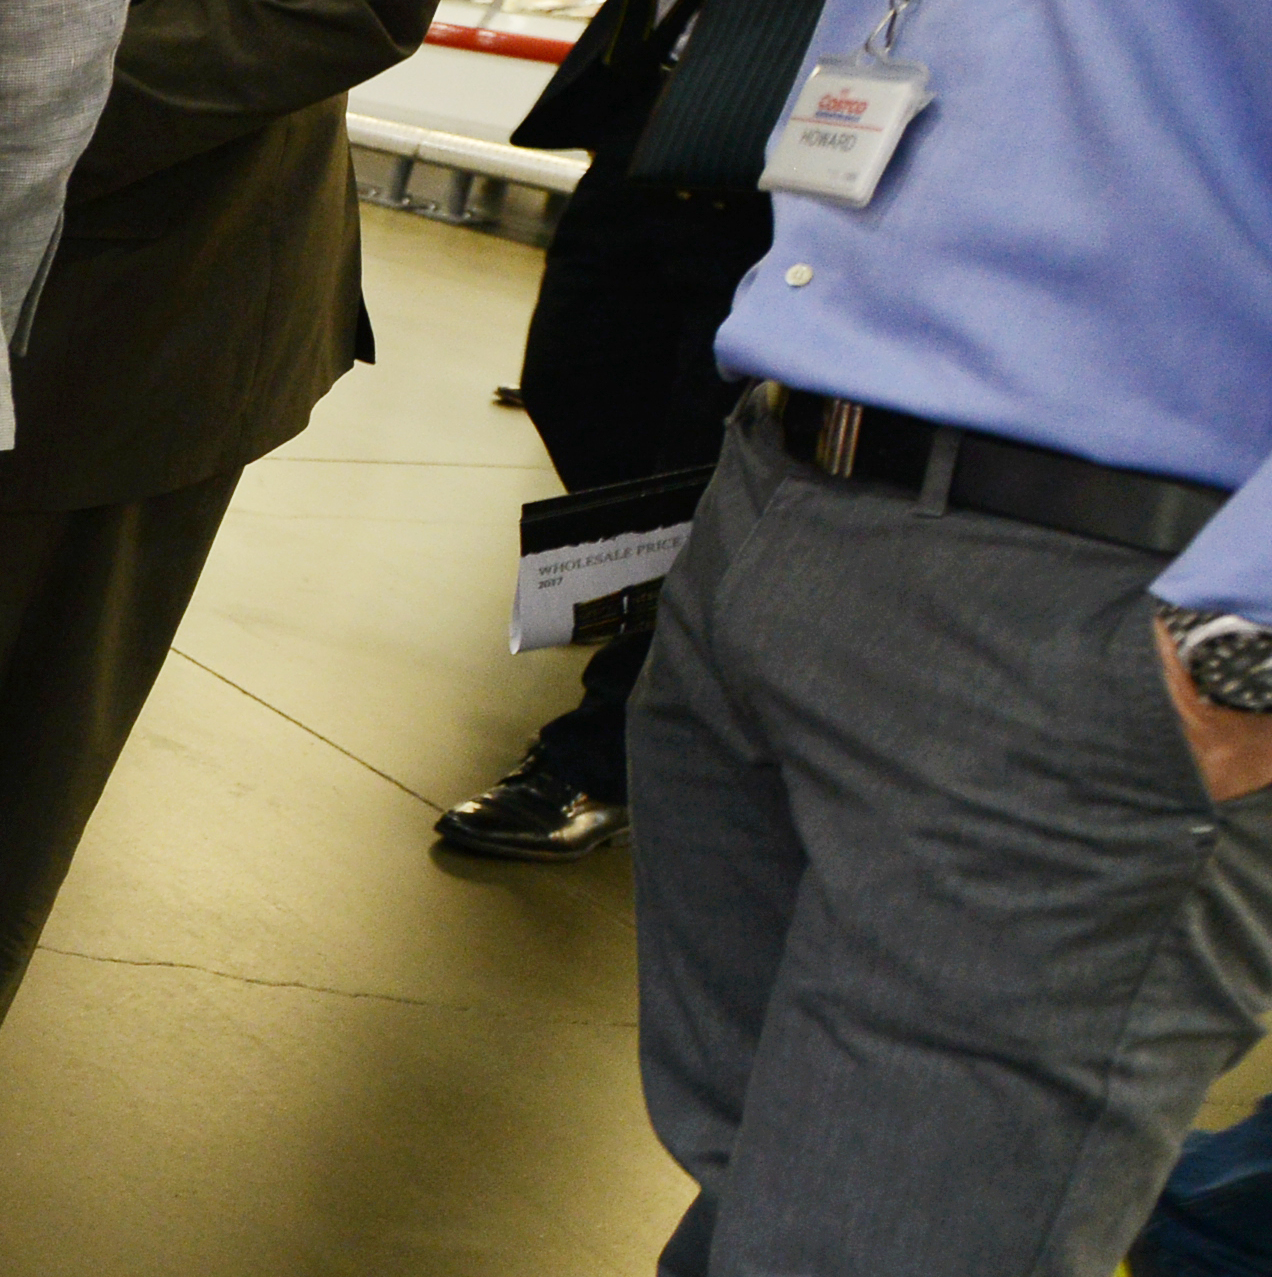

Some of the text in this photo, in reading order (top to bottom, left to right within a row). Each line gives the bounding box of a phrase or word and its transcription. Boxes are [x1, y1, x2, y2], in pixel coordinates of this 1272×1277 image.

[799, 128, 858, 153] HOWARD
[538, 535, 683, 576] WHOLESALE PRICE
[537, 576, 564, 591] 2017
